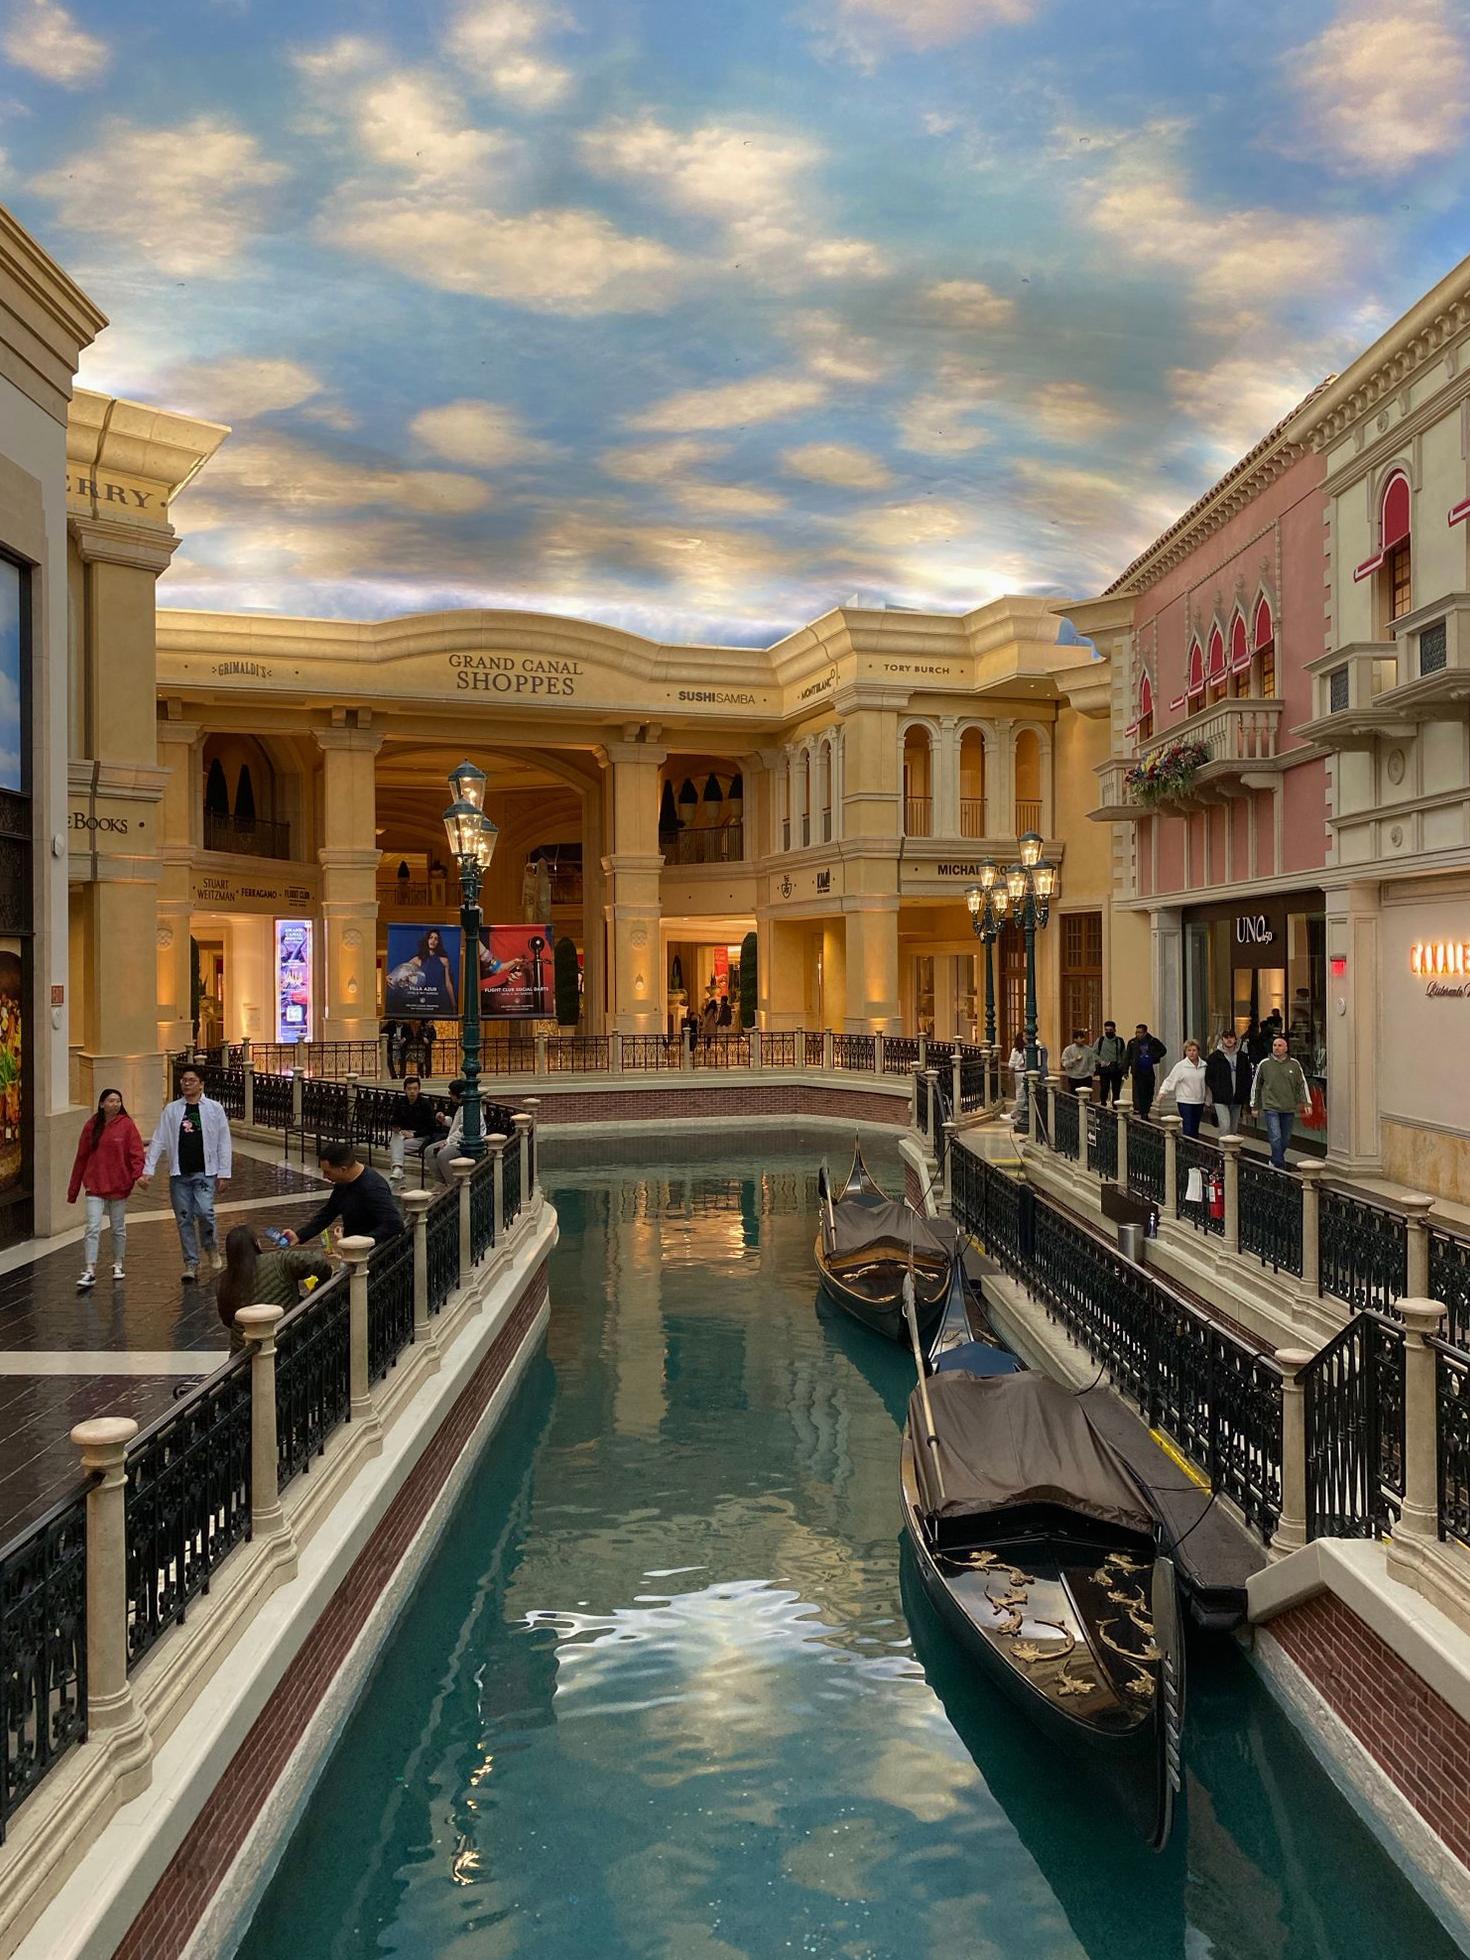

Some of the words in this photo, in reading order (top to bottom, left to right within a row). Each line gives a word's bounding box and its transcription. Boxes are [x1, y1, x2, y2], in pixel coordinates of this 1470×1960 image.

[449, 654, 515, 671] GRAND
[522, 659, 584, 675] CANAL
[884, 664, 911, 673] TORY
[914, 665, 950, 675] BURCH
[456, 671, 575, 696] SHOPPES
[203, 879, 229, 890] STUART
[197, 889, 235, 902] WEITZMAN
[241, 888, 277, 899] FERRAGAMO
